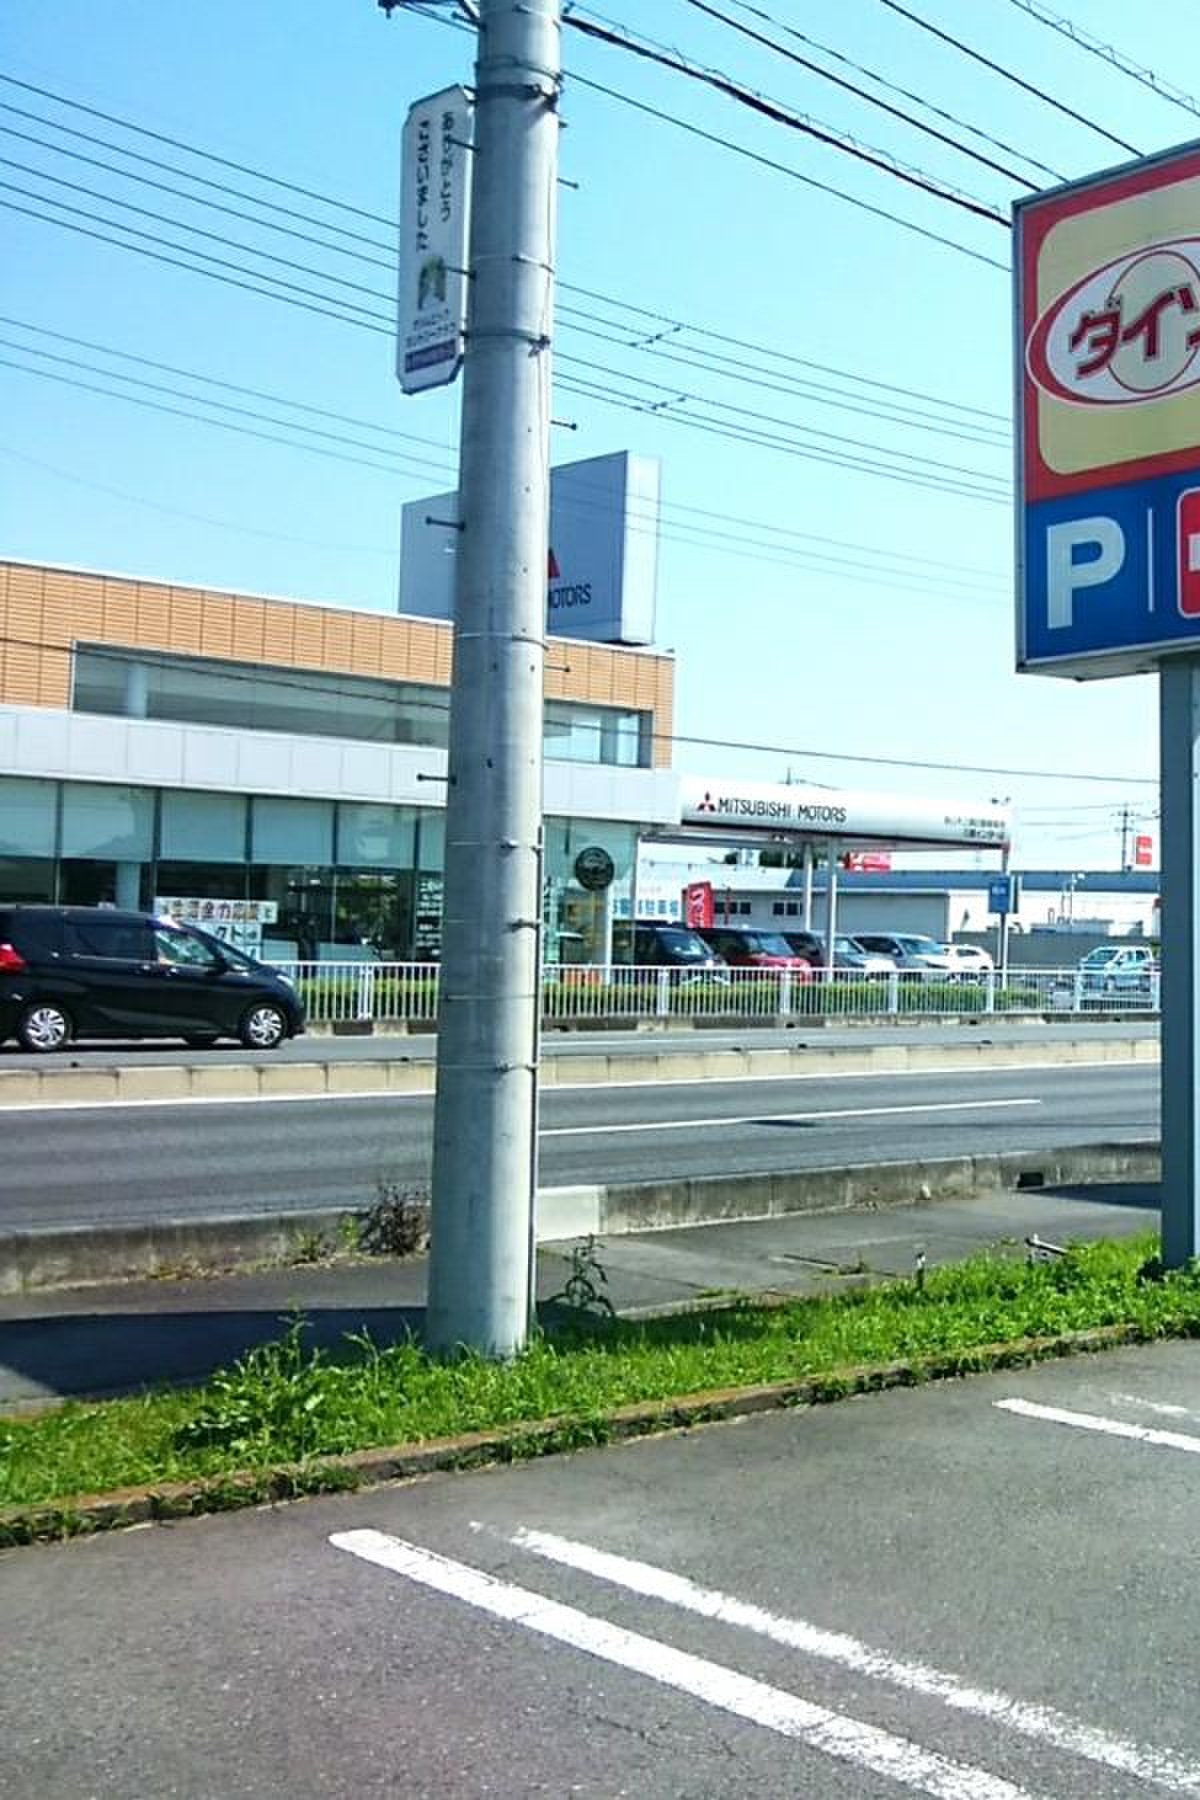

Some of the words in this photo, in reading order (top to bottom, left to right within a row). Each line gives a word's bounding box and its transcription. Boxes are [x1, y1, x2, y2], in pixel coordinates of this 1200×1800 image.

[1046, 515, 1126, 630] P
[548, 583, 593, 609] OTORS
[718, 797, 793, 817] MITSUBISHI
[798, 803, 848, 823] MOTORS
